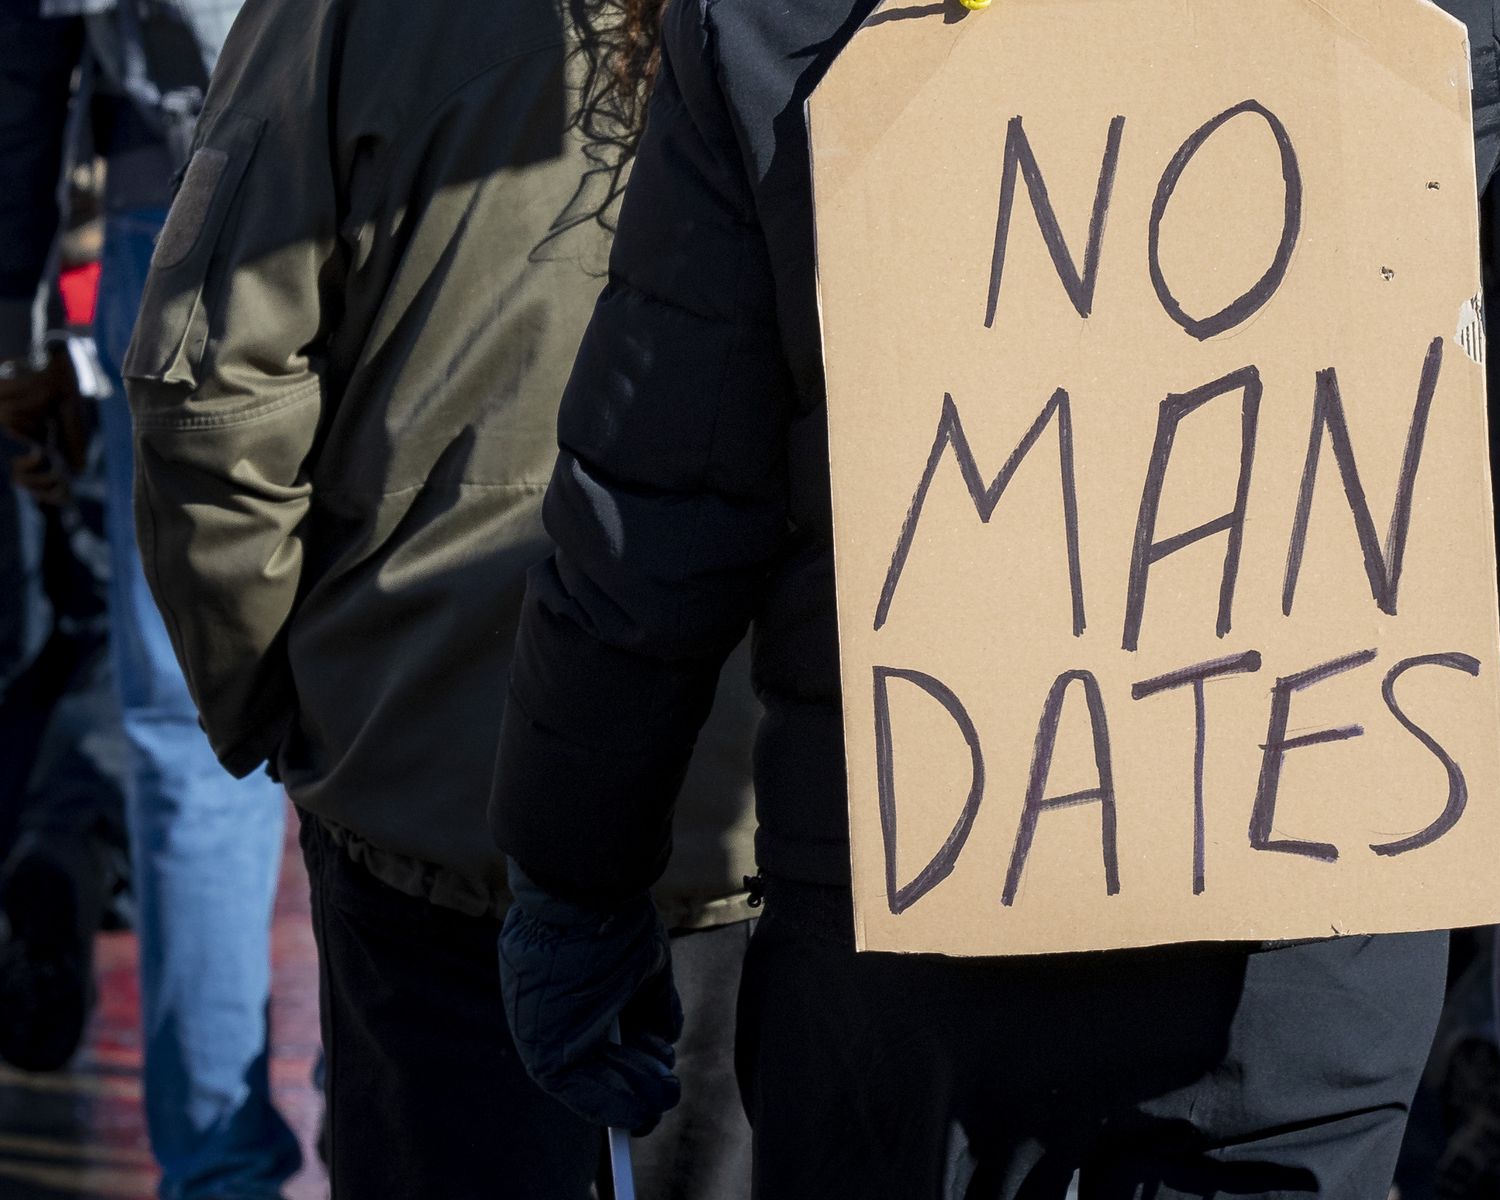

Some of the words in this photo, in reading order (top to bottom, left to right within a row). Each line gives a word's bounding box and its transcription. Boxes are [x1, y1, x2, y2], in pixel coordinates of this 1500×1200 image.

[985, 99, 1302, 341] NO
[873, 336, 1443, 651] MAN
[873, 648, 1482, 915] DATES
